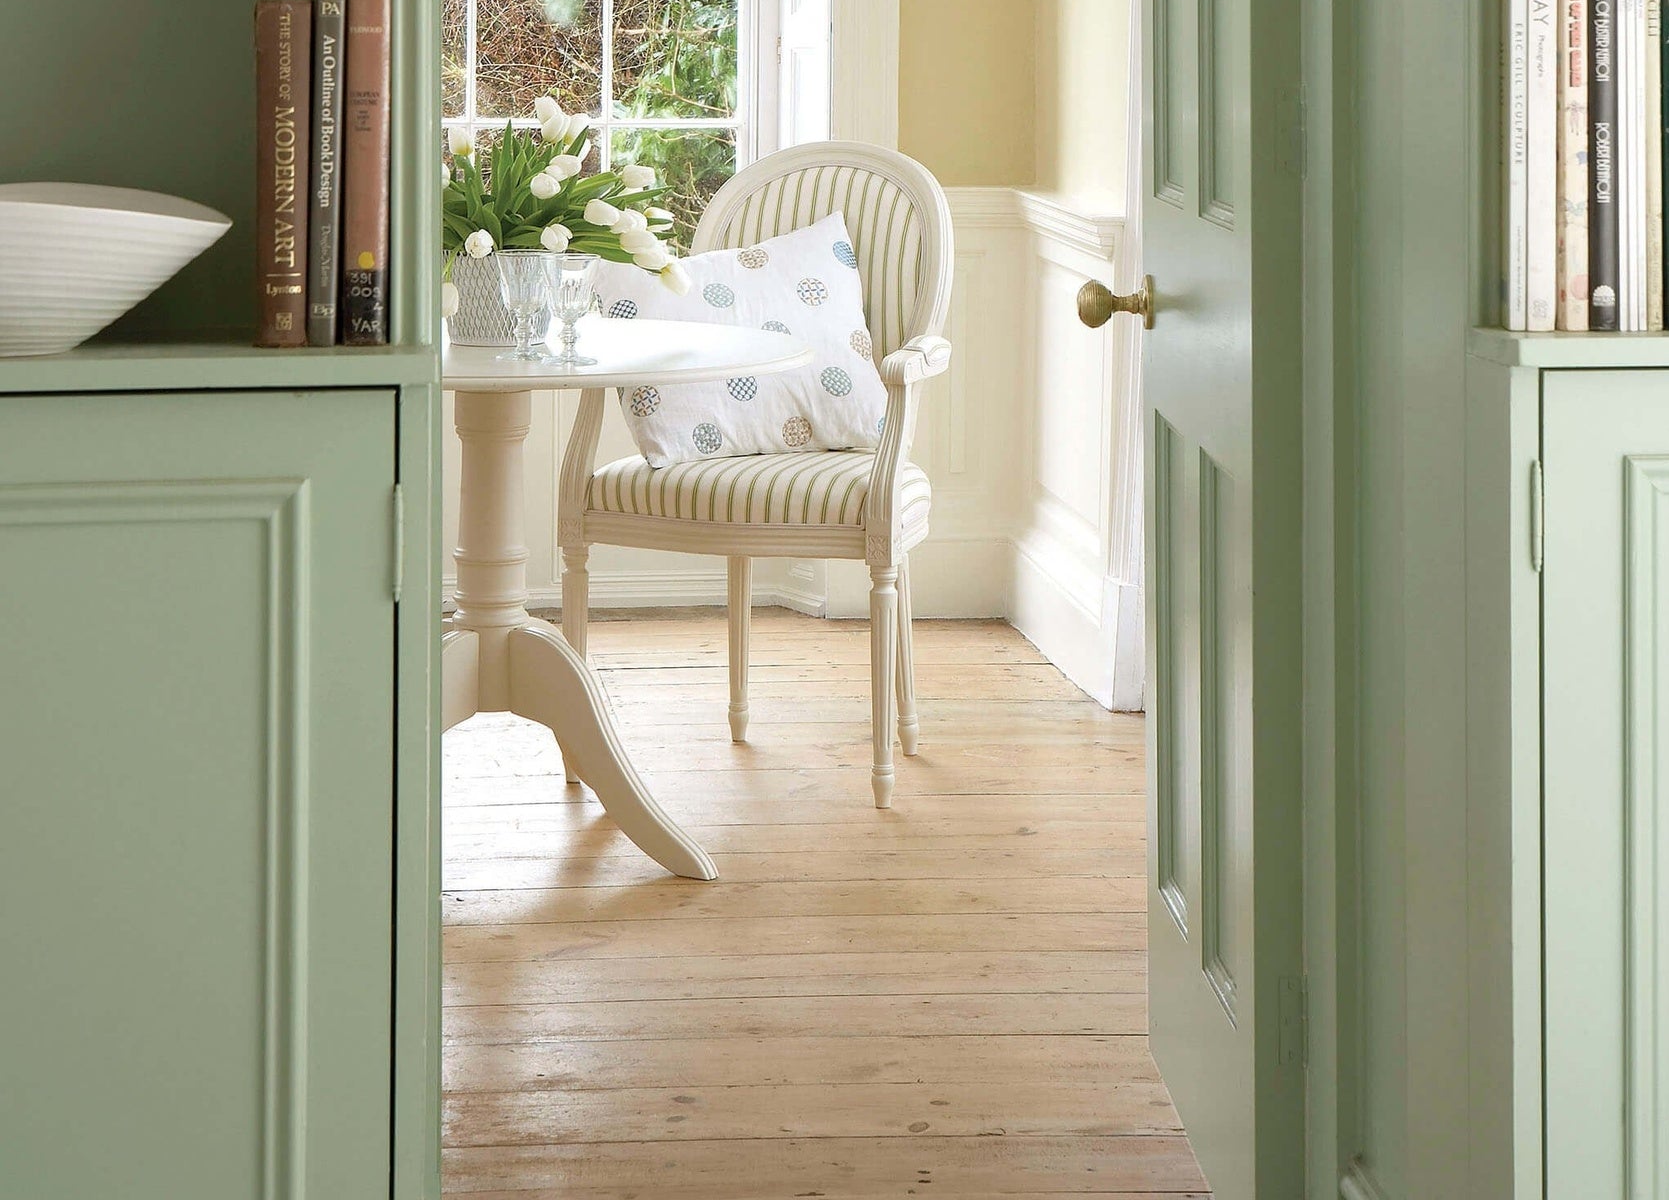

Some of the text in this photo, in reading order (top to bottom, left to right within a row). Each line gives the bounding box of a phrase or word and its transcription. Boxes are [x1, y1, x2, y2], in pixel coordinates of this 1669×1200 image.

[322, 2, 340, 15] PA
[1595, 0, 1610, 17] OF
[1514, 23, 1524, 165] ERIC GILL SCULPTURE
[317, 34, 336, 208] An Outline of Book Design
[274, 13, 295, 268] THE STORY OF MODERN ART
[350, 272, 372, 285] 391
[351, 317, 381, 332] YAR
